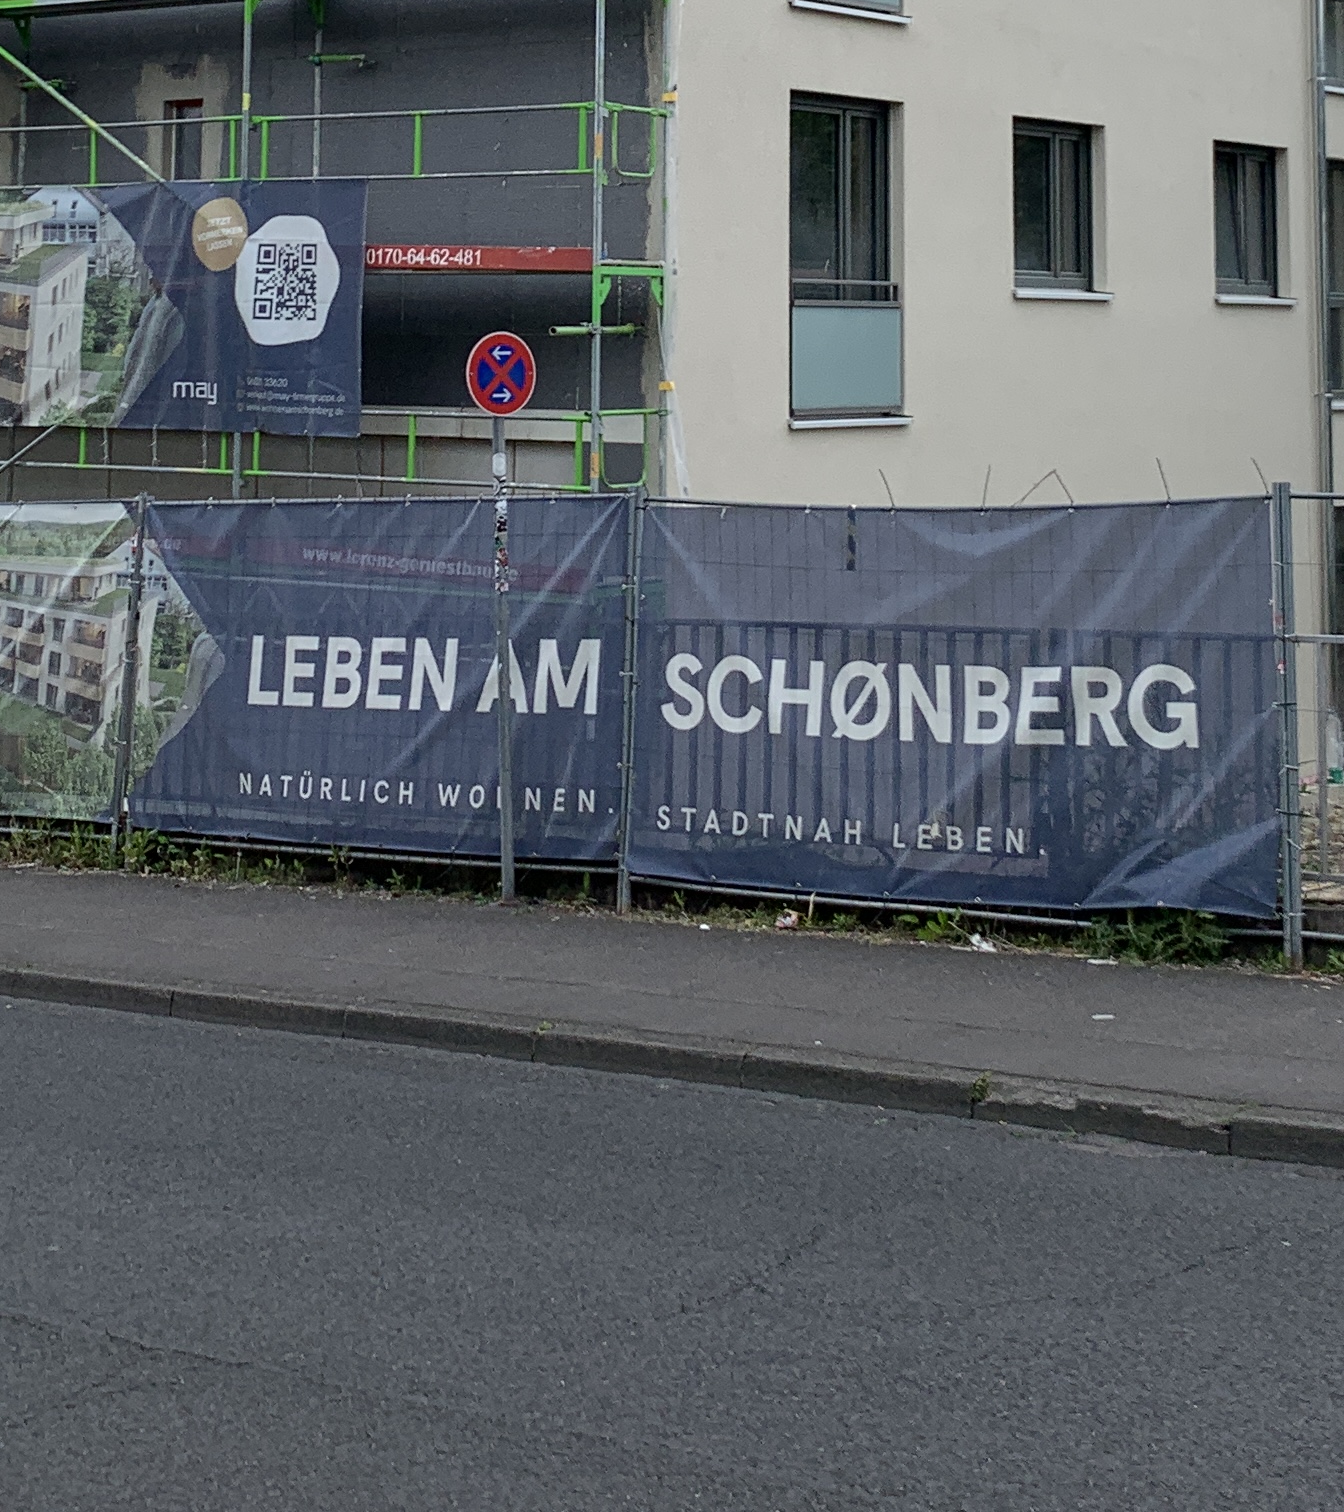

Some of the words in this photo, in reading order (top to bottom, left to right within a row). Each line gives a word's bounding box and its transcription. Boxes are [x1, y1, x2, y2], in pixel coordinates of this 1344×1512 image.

[366, 248, 482, 266] 0170-64-62-481
[173, 381, 218, 405] may
[247, 635, 459, 712] LEBEN
[475, 638, 601, 715] AM
[660, 652, 1200, 750] SCHØNBERG
[239, 769, 414, 805] NATÜRLICH
[656, 805, 862, 845] STADTNAH
[893, 822, 1047, 856] LEBEN.
